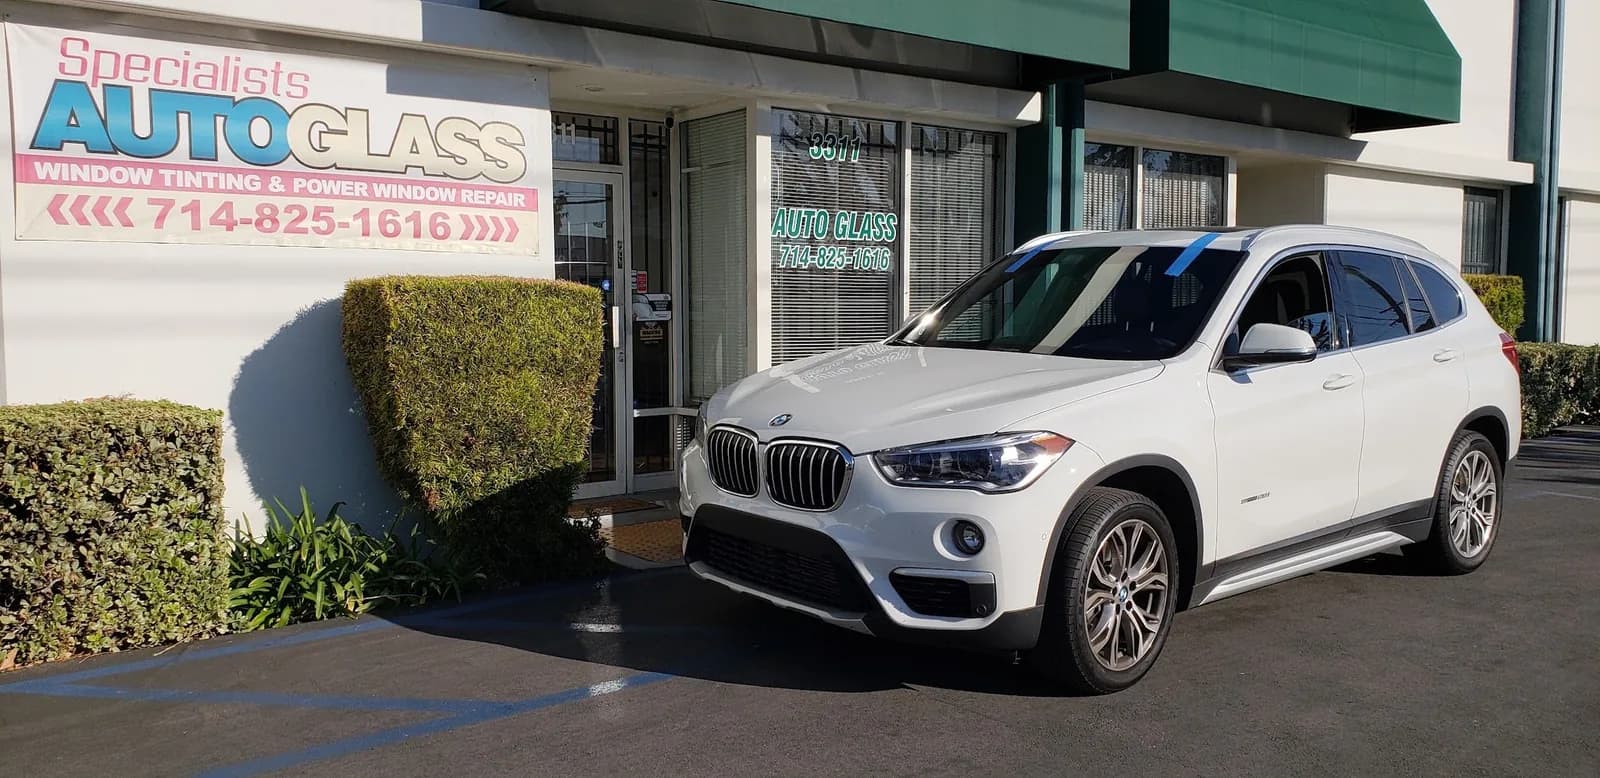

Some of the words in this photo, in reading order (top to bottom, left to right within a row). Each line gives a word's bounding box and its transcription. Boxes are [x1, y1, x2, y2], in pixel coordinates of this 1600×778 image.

[58, 36, 310, 99] Specialists
[809, 132, 862, 162] 3311
[34, 161, 153, 186] WINDOW
[158, 168, 262, 192] TINTING
[267, 175, 286, 193] &
[293, 178, 369, 198] POWER
[373, 182, 457, 203] WINDOW
[461, 189, 527, 208] REPAIR
[147, 198, 452, 241] 714-825-1616
[771, 208, 830, 239] AUTO
[834, 211, 898, 242] GLASS
[779, 244, 891, 271] 714-825-1616
